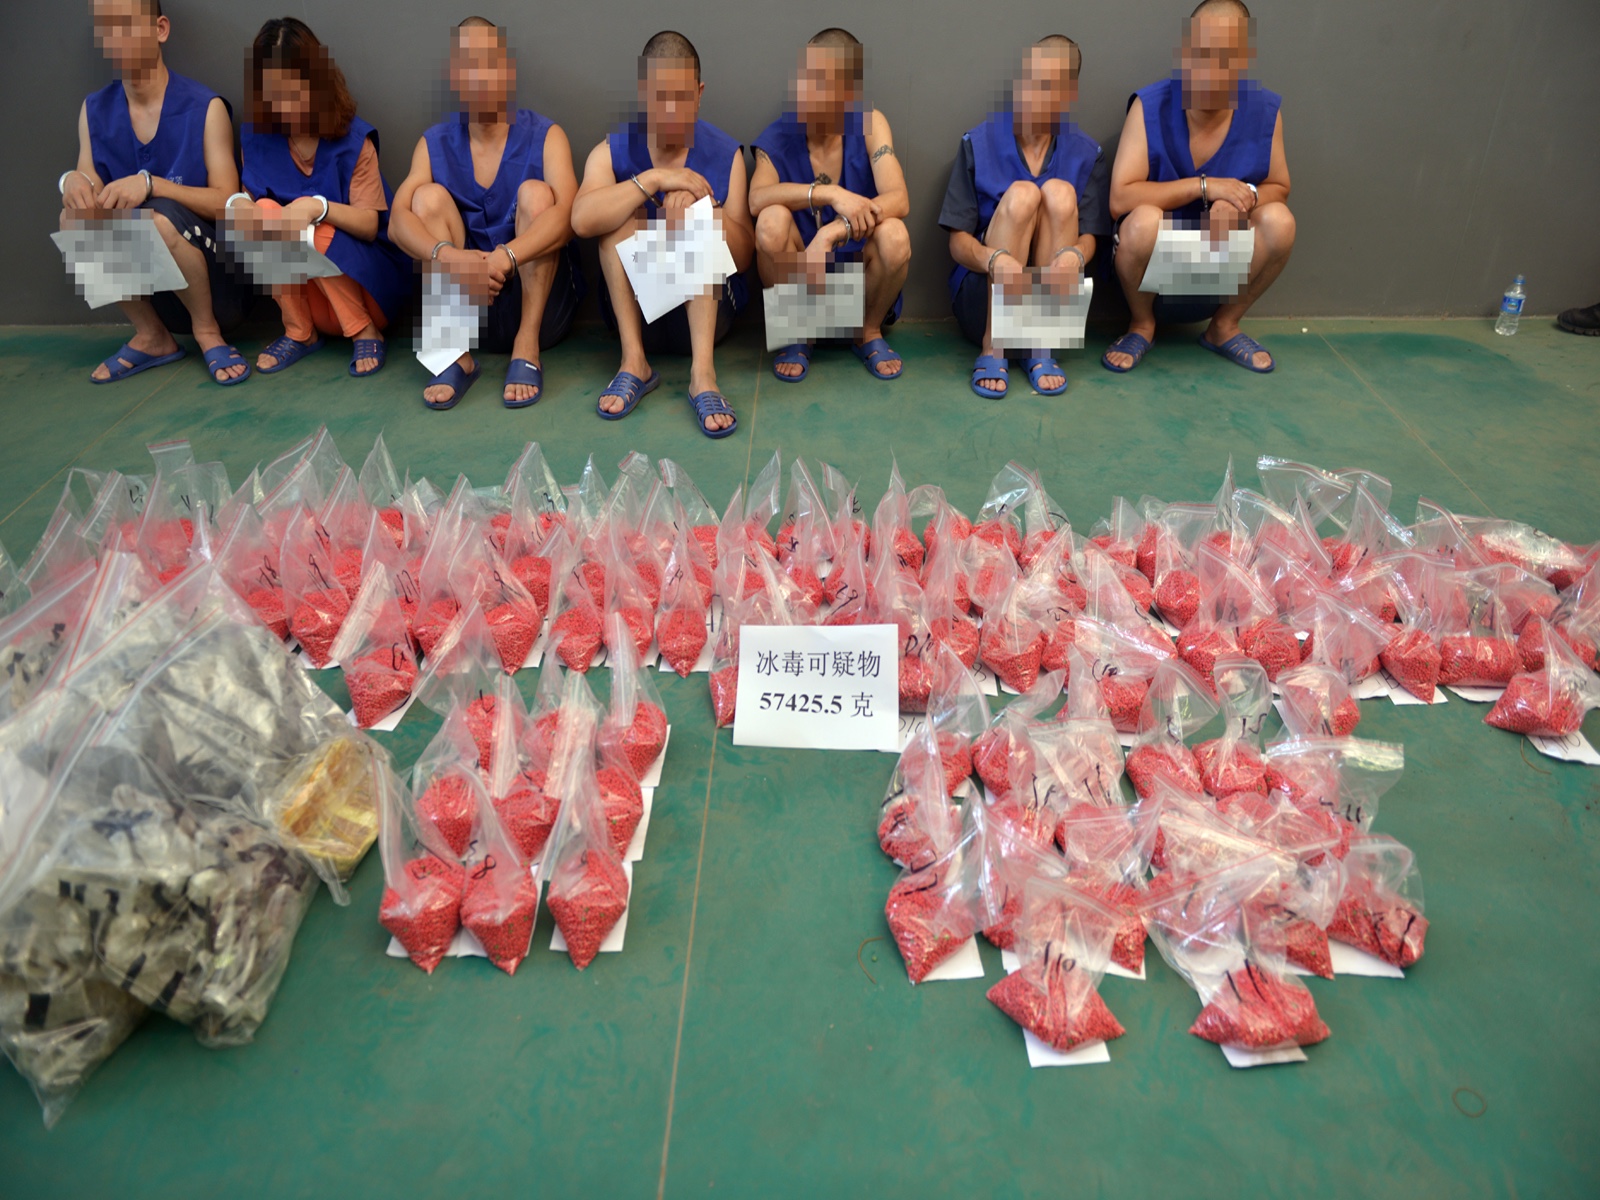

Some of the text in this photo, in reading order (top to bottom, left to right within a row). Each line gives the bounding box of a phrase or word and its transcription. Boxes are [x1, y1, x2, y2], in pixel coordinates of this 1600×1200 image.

[756, 650, 881, 678] 冰毒可疑物
[759, 691, 874, 718] 57425.5 克
